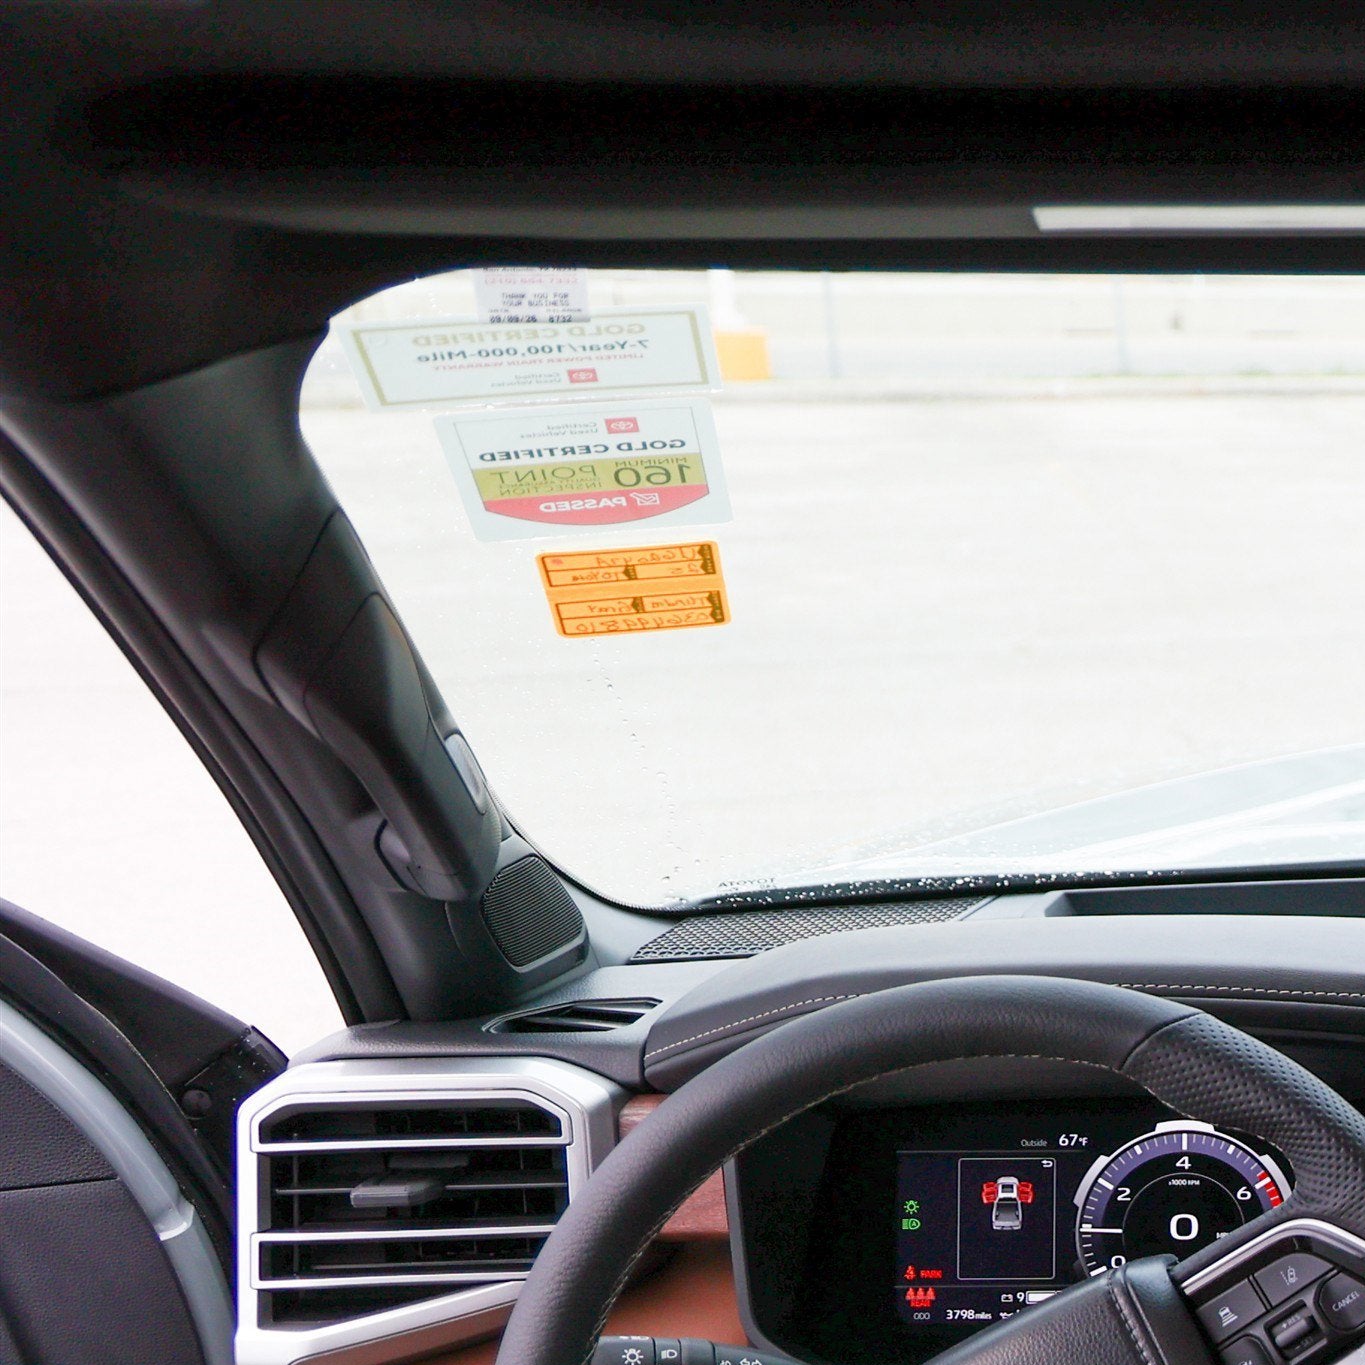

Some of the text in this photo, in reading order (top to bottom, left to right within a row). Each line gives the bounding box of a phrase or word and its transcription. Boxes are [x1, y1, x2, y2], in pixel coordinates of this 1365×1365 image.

[1021, 1138, 1048, 1147] Outside
[1176, 1156, 1191, 1170] 4
[1117, 1187, 1131, 1201] 2
[1236, 1186, 1252, 1200] 6
[1170, 1213, 1199, 1240] 0
[1111, 1255, 1126, 1269] 0
[1332, 1290, 1360, 1312] CANCEL
